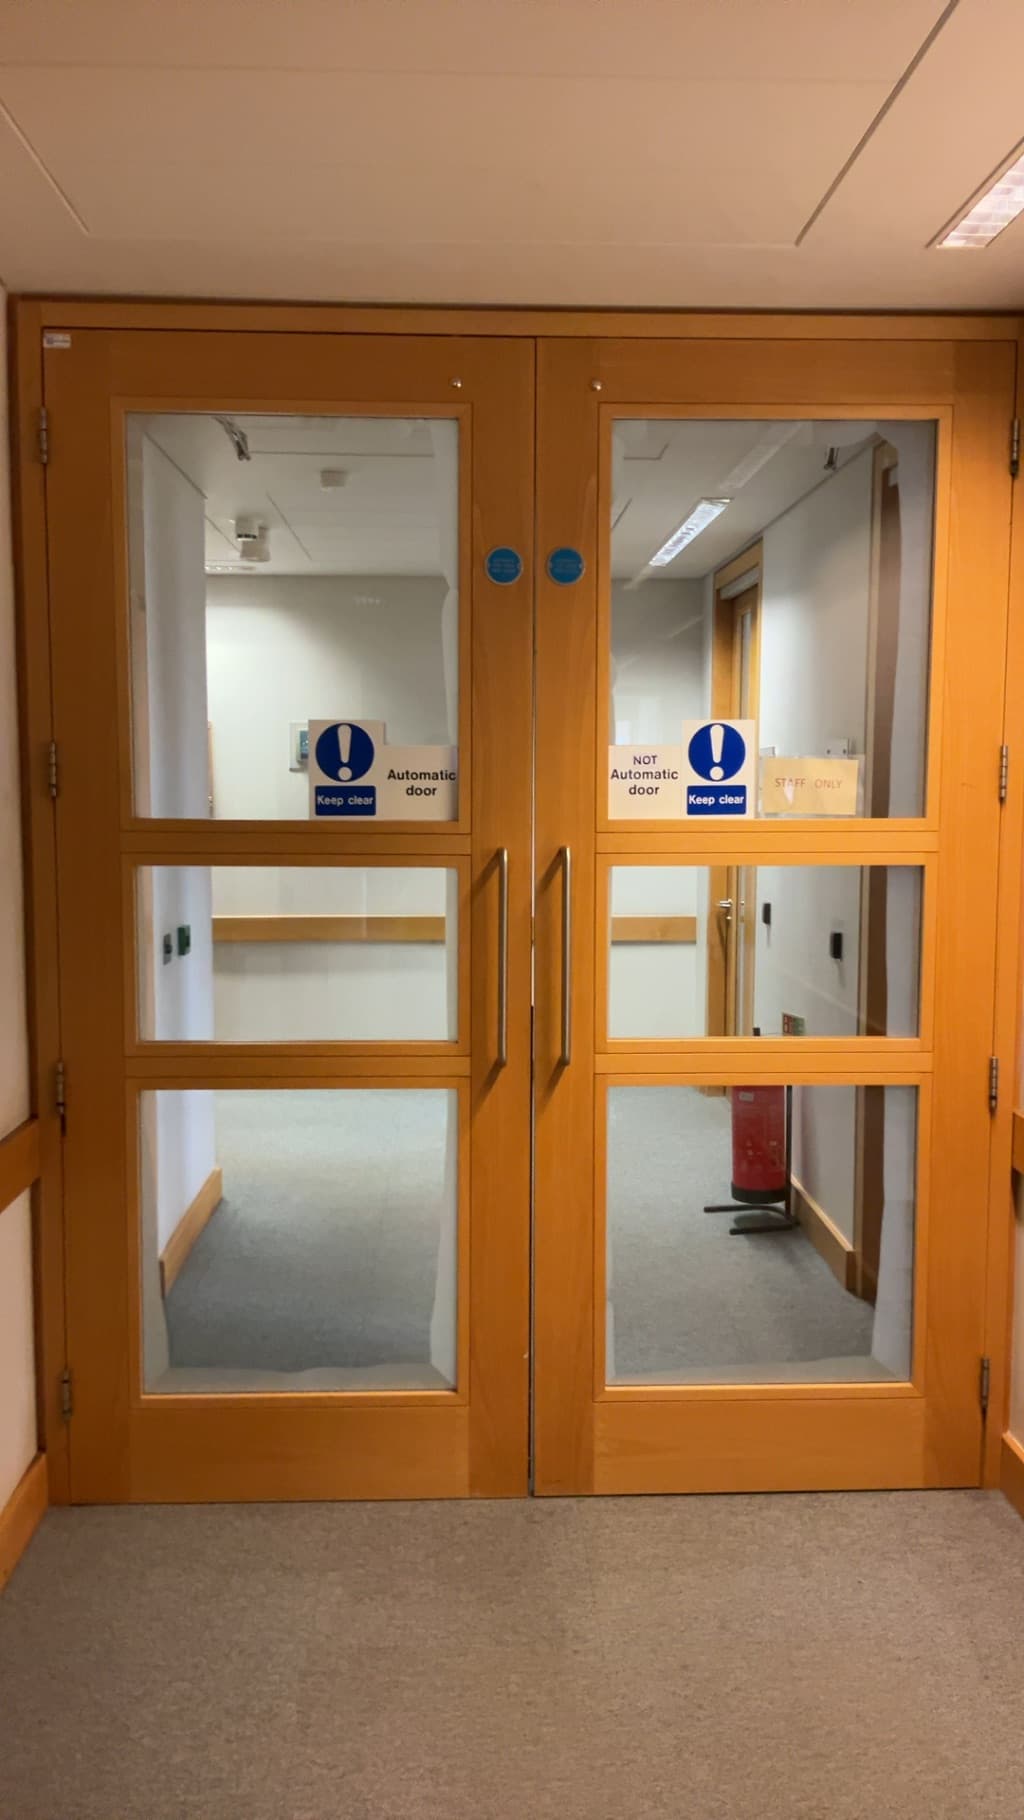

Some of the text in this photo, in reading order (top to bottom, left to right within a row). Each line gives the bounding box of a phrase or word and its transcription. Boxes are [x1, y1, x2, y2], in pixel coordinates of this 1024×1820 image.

[633, 755, 658, 765] NOT
[387, 769, 456, 781] Automatic
[610, 768, 679, 780] Automatic
[775, 777, 843, 789] STAFF ONLY
[406, 785, 437, 796] door
[628, 784, 660, 795] door
[317, 795, 373, 807] Keep clear
[688, 794, 744, 805] Keep clear
